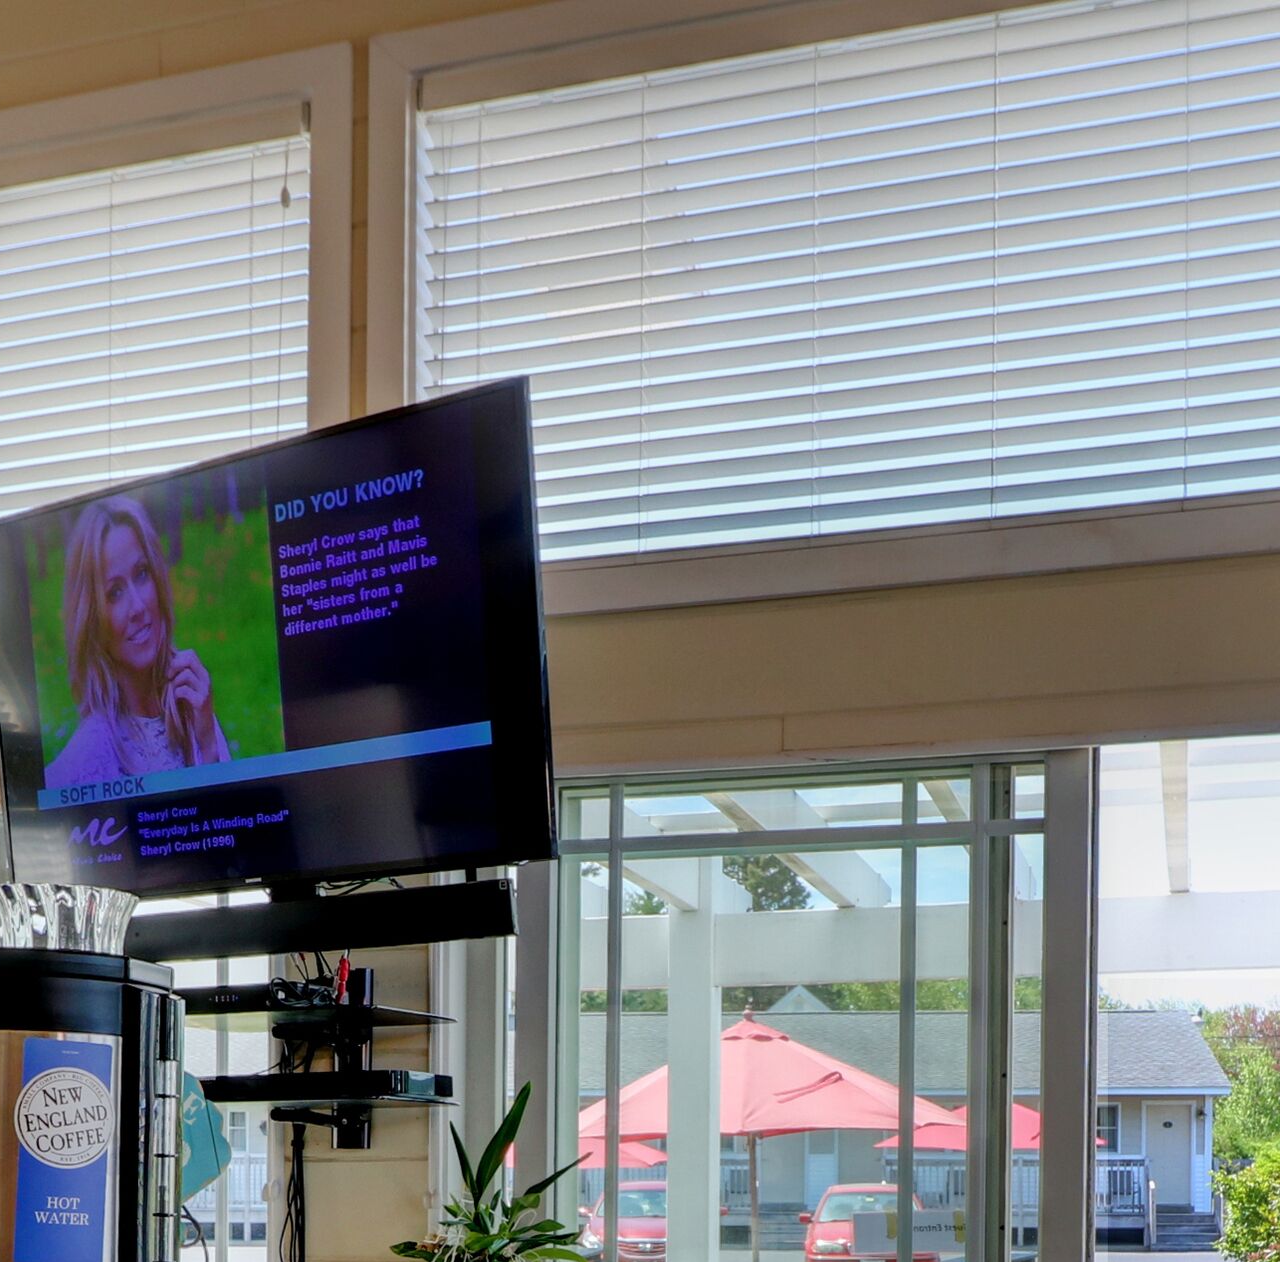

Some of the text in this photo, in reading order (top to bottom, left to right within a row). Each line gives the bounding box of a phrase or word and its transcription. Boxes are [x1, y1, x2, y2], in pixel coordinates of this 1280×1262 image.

[274, 468, 424, 523] DID YOU KNOW?
[278, 514, 420, 559] Sheryl Crow says that
[279, 534, 427, 579] Bonnie Raitt and Mavis
[281, 554, 438, 597] Staples might as well be
[282, 582, 404, 617] her "sisters from a
[284, 599, 399, 636] different mother."
[60, 777, 146, 804] SOFT ROCK
[137, 806, 198, 823] Sheryl Crow
[138, 808, 290, 839] "Everyday Is A Winding Road"
[140, 835, 236, 858] Sheryl Crow (1996)
[35, 1073, 67, 1090] COMPANY
[42, 1086, 82, 1107] NEW
[24, 1104, 107, 1132] ENGLAND
[36, 1127, 105, 1153] COFFEE
[46, 1195, 81, 1210] HOT
[34, 1210, 90, 1227] WATER
